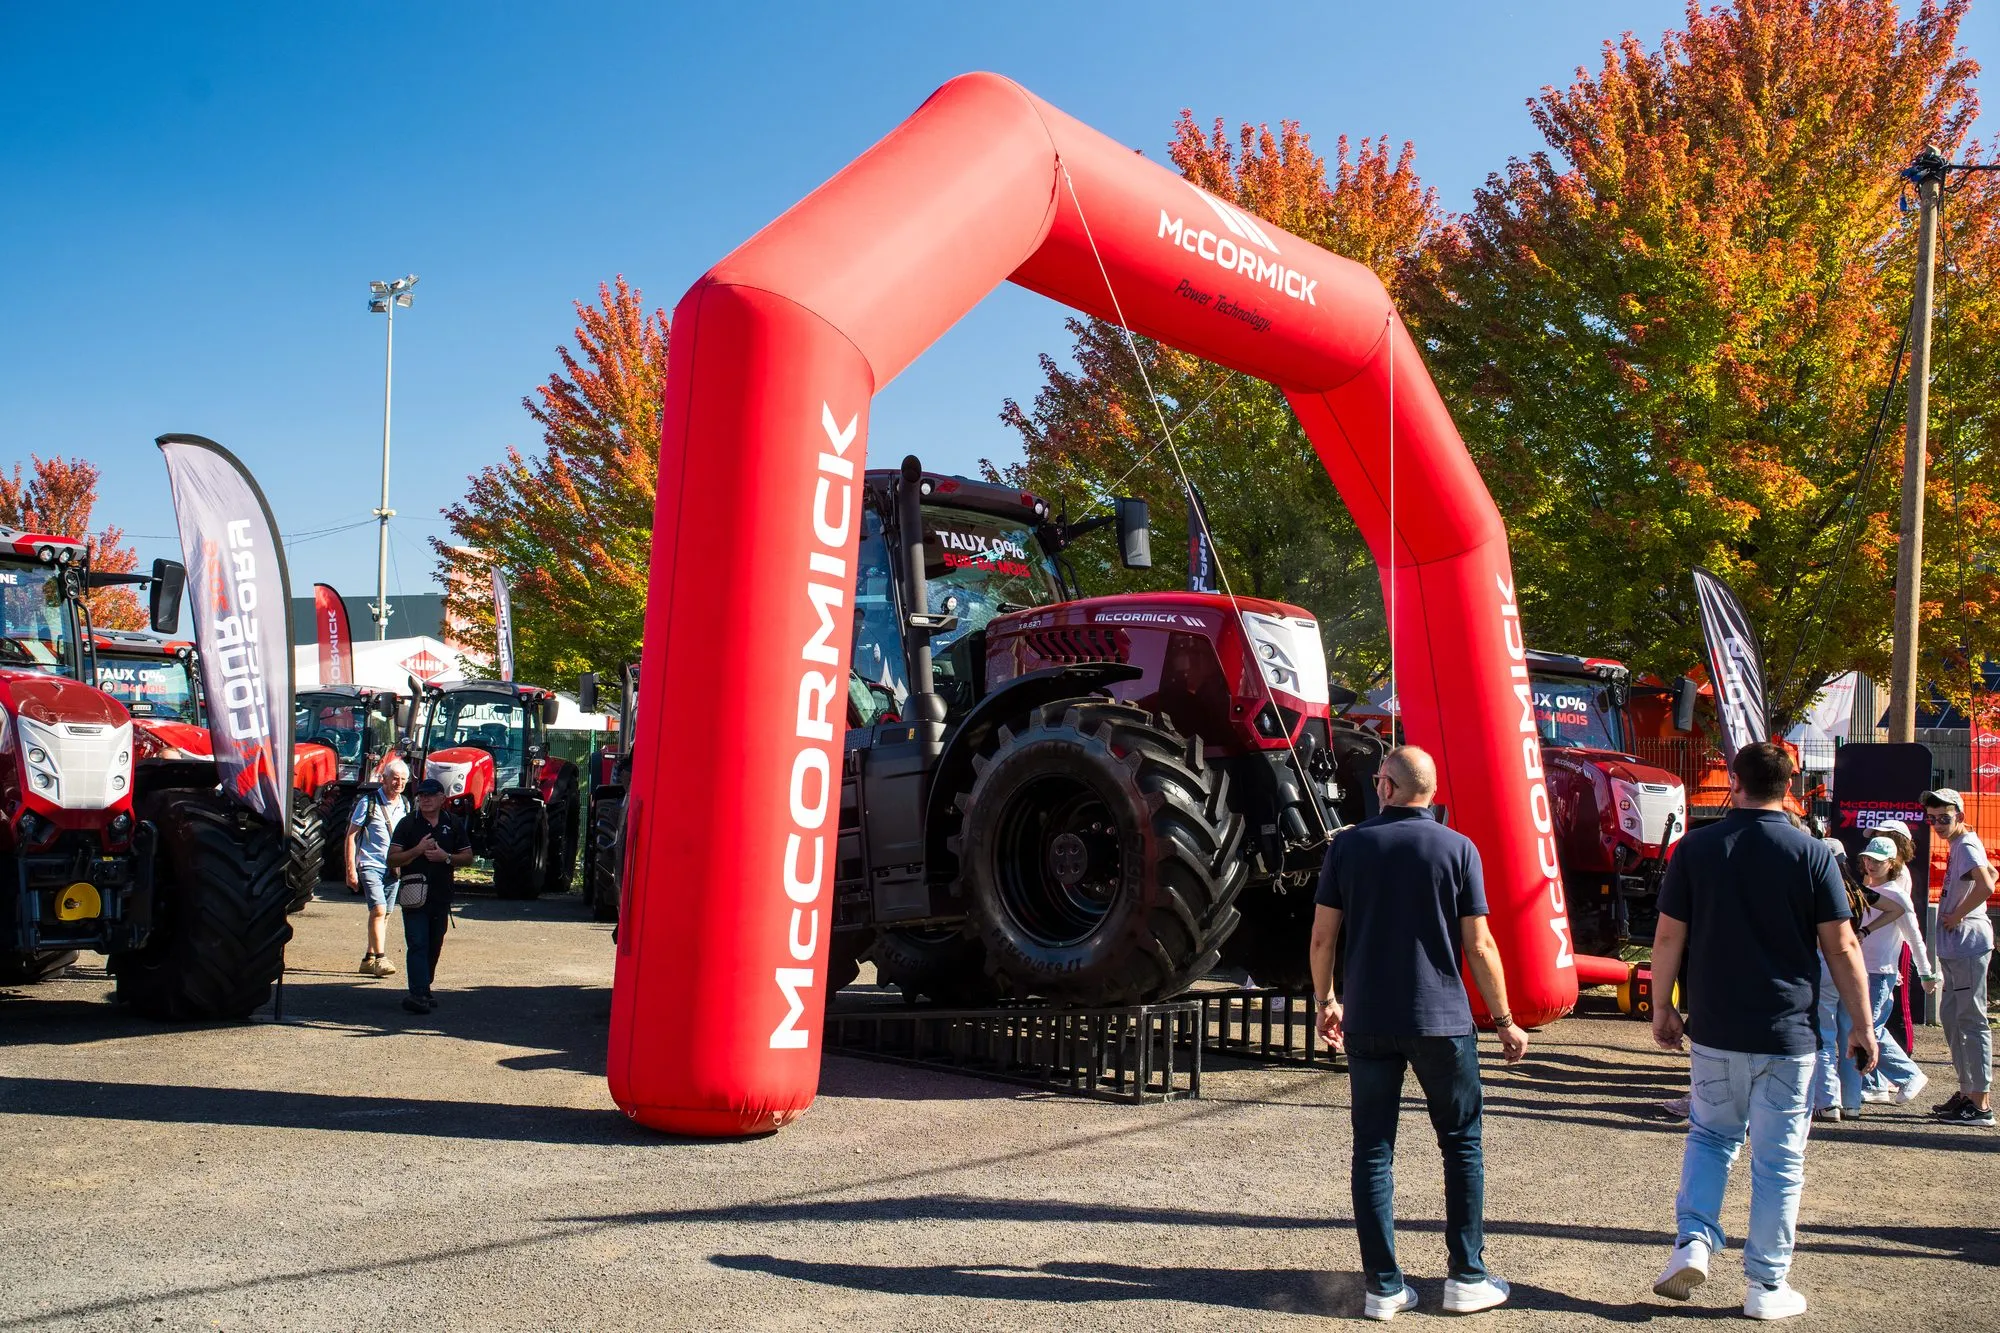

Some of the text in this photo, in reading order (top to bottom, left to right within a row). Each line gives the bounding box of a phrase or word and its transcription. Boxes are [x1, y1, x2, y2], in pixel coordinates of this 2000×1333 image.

[1158, 208, 1318, 306] McCORMICK
[1174, 279, 1212, 305] Power
[936, 530, 1024, 559] TAUX 0%
[943, 553, 974, 568] SUR
[997, 560, 1031, 577] MOIS
[1095, 613, 1178, 623] McCORMICK
[406, 658, 444, 671] KUHN
[97, 667, 136, 680] TAUX
[1556, 695, 1587, 711] 0%
[769, 400, 858, 1049] McCORMICK
[1556, 712, 1588, 726] MOIS
[1495, 572, 1574, 970] McCORMICK
[1840, 801, 1924, 810] McCORMICK
[1857, 811, 1924, 821] FACTORY
